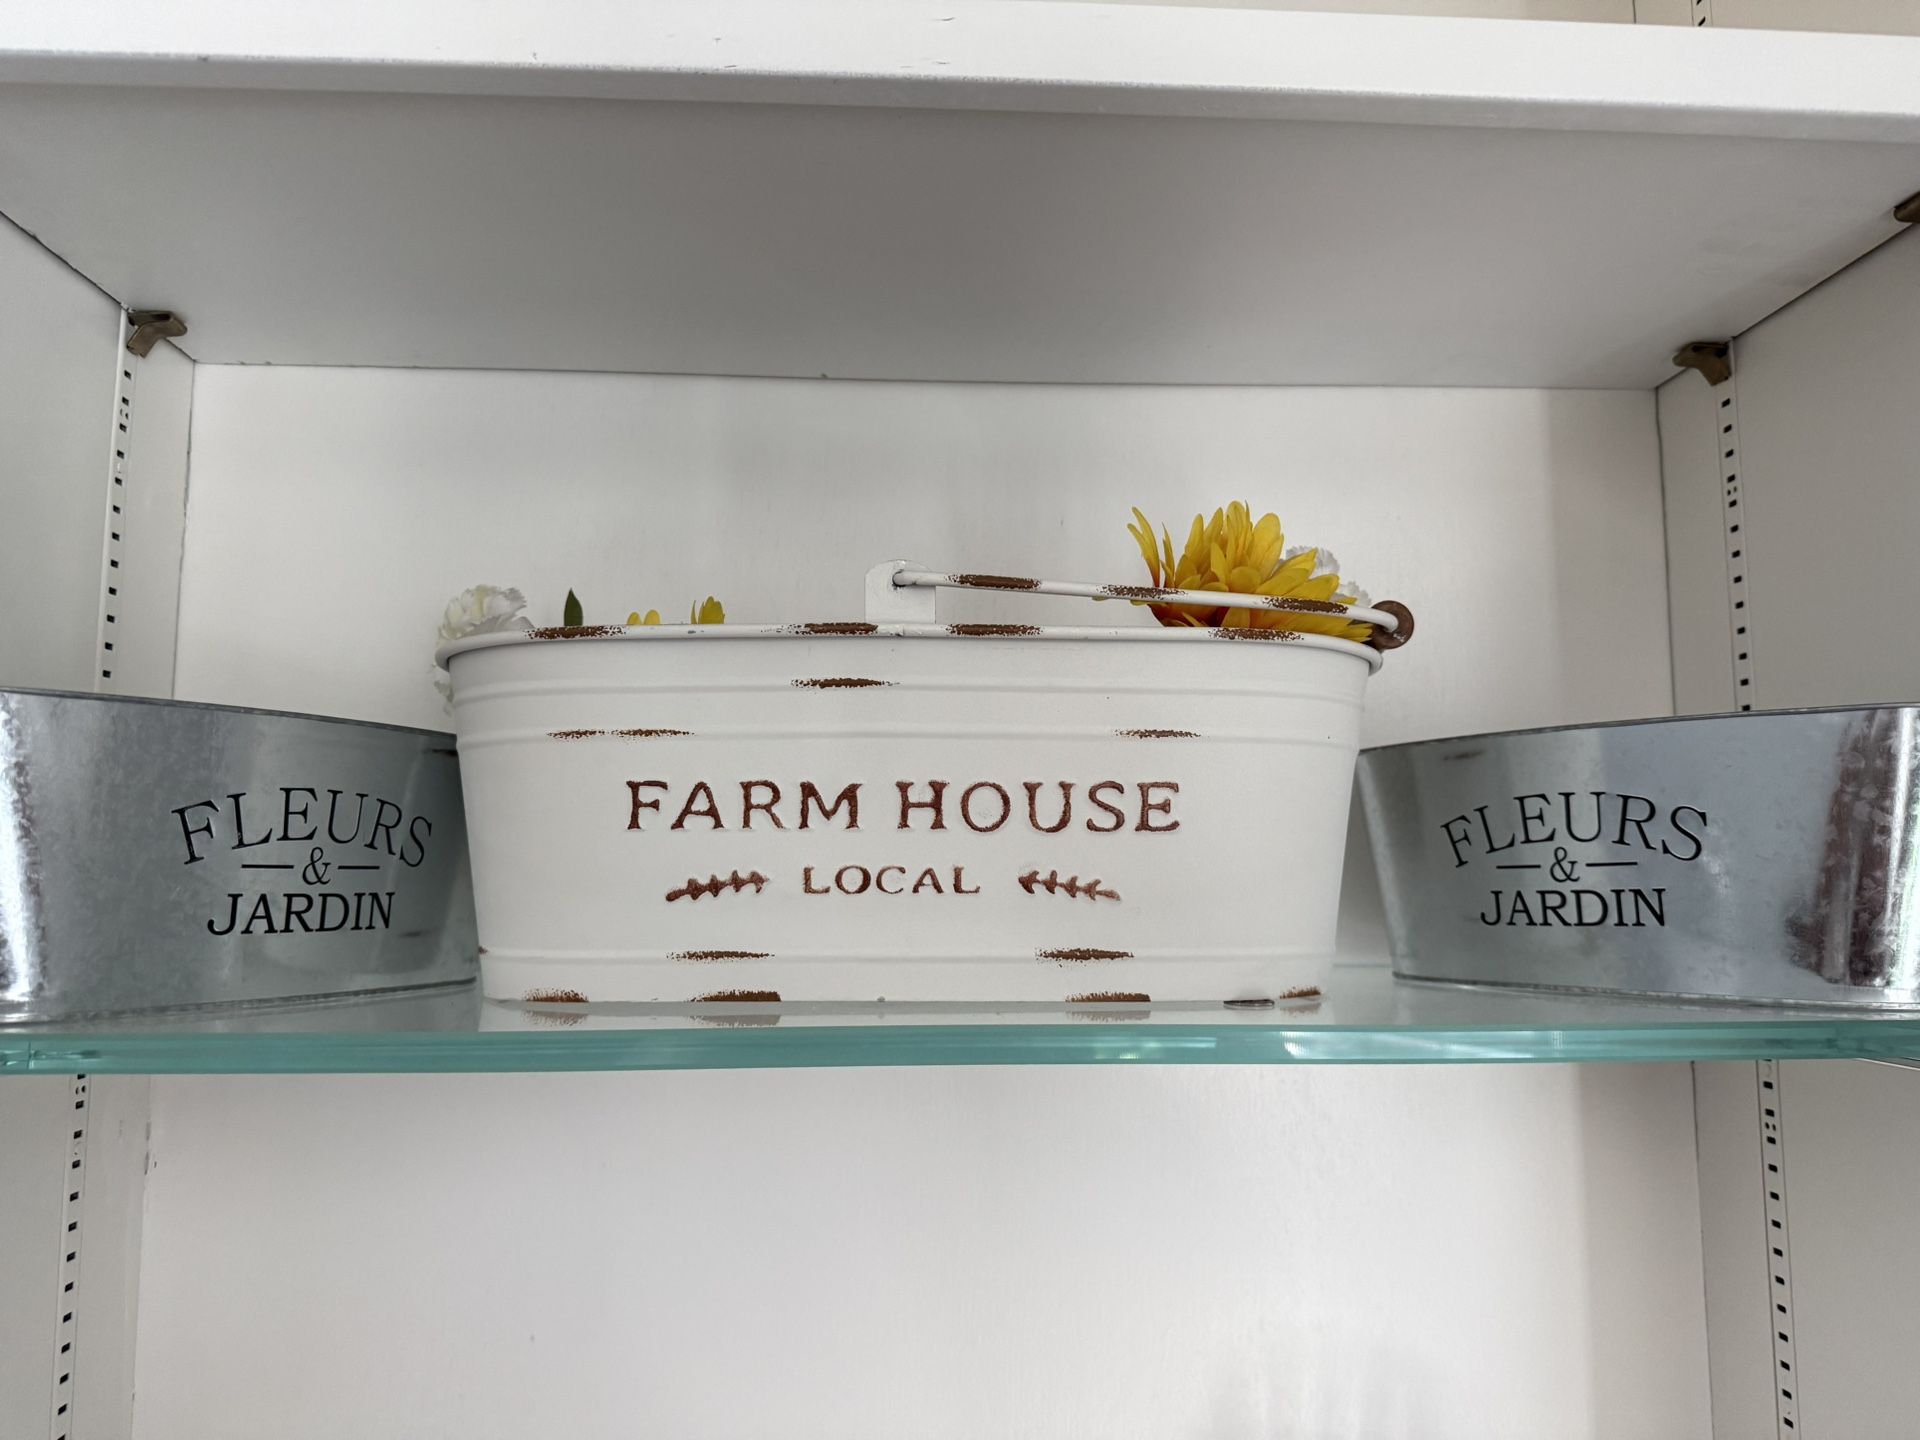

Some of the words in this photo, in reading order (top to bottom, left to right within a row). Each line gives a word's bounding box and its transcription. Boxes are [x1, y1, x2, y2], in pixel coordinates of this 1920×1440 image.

[171, 786, 433, 867] FLEURS
[625, 779, 864, 831] FARM
[895, 779, 1181, 833] HOUSE
[1440, 790, 1708, 868] FLEURS
[301, 846, 332, 886] &
[802, 865, 981, 896] LOCAL
[1549, 846, 1581, 883] &
[206, 891, 396, 937] JARDIN
[1479, 887, 1667, 928] JARDIN
